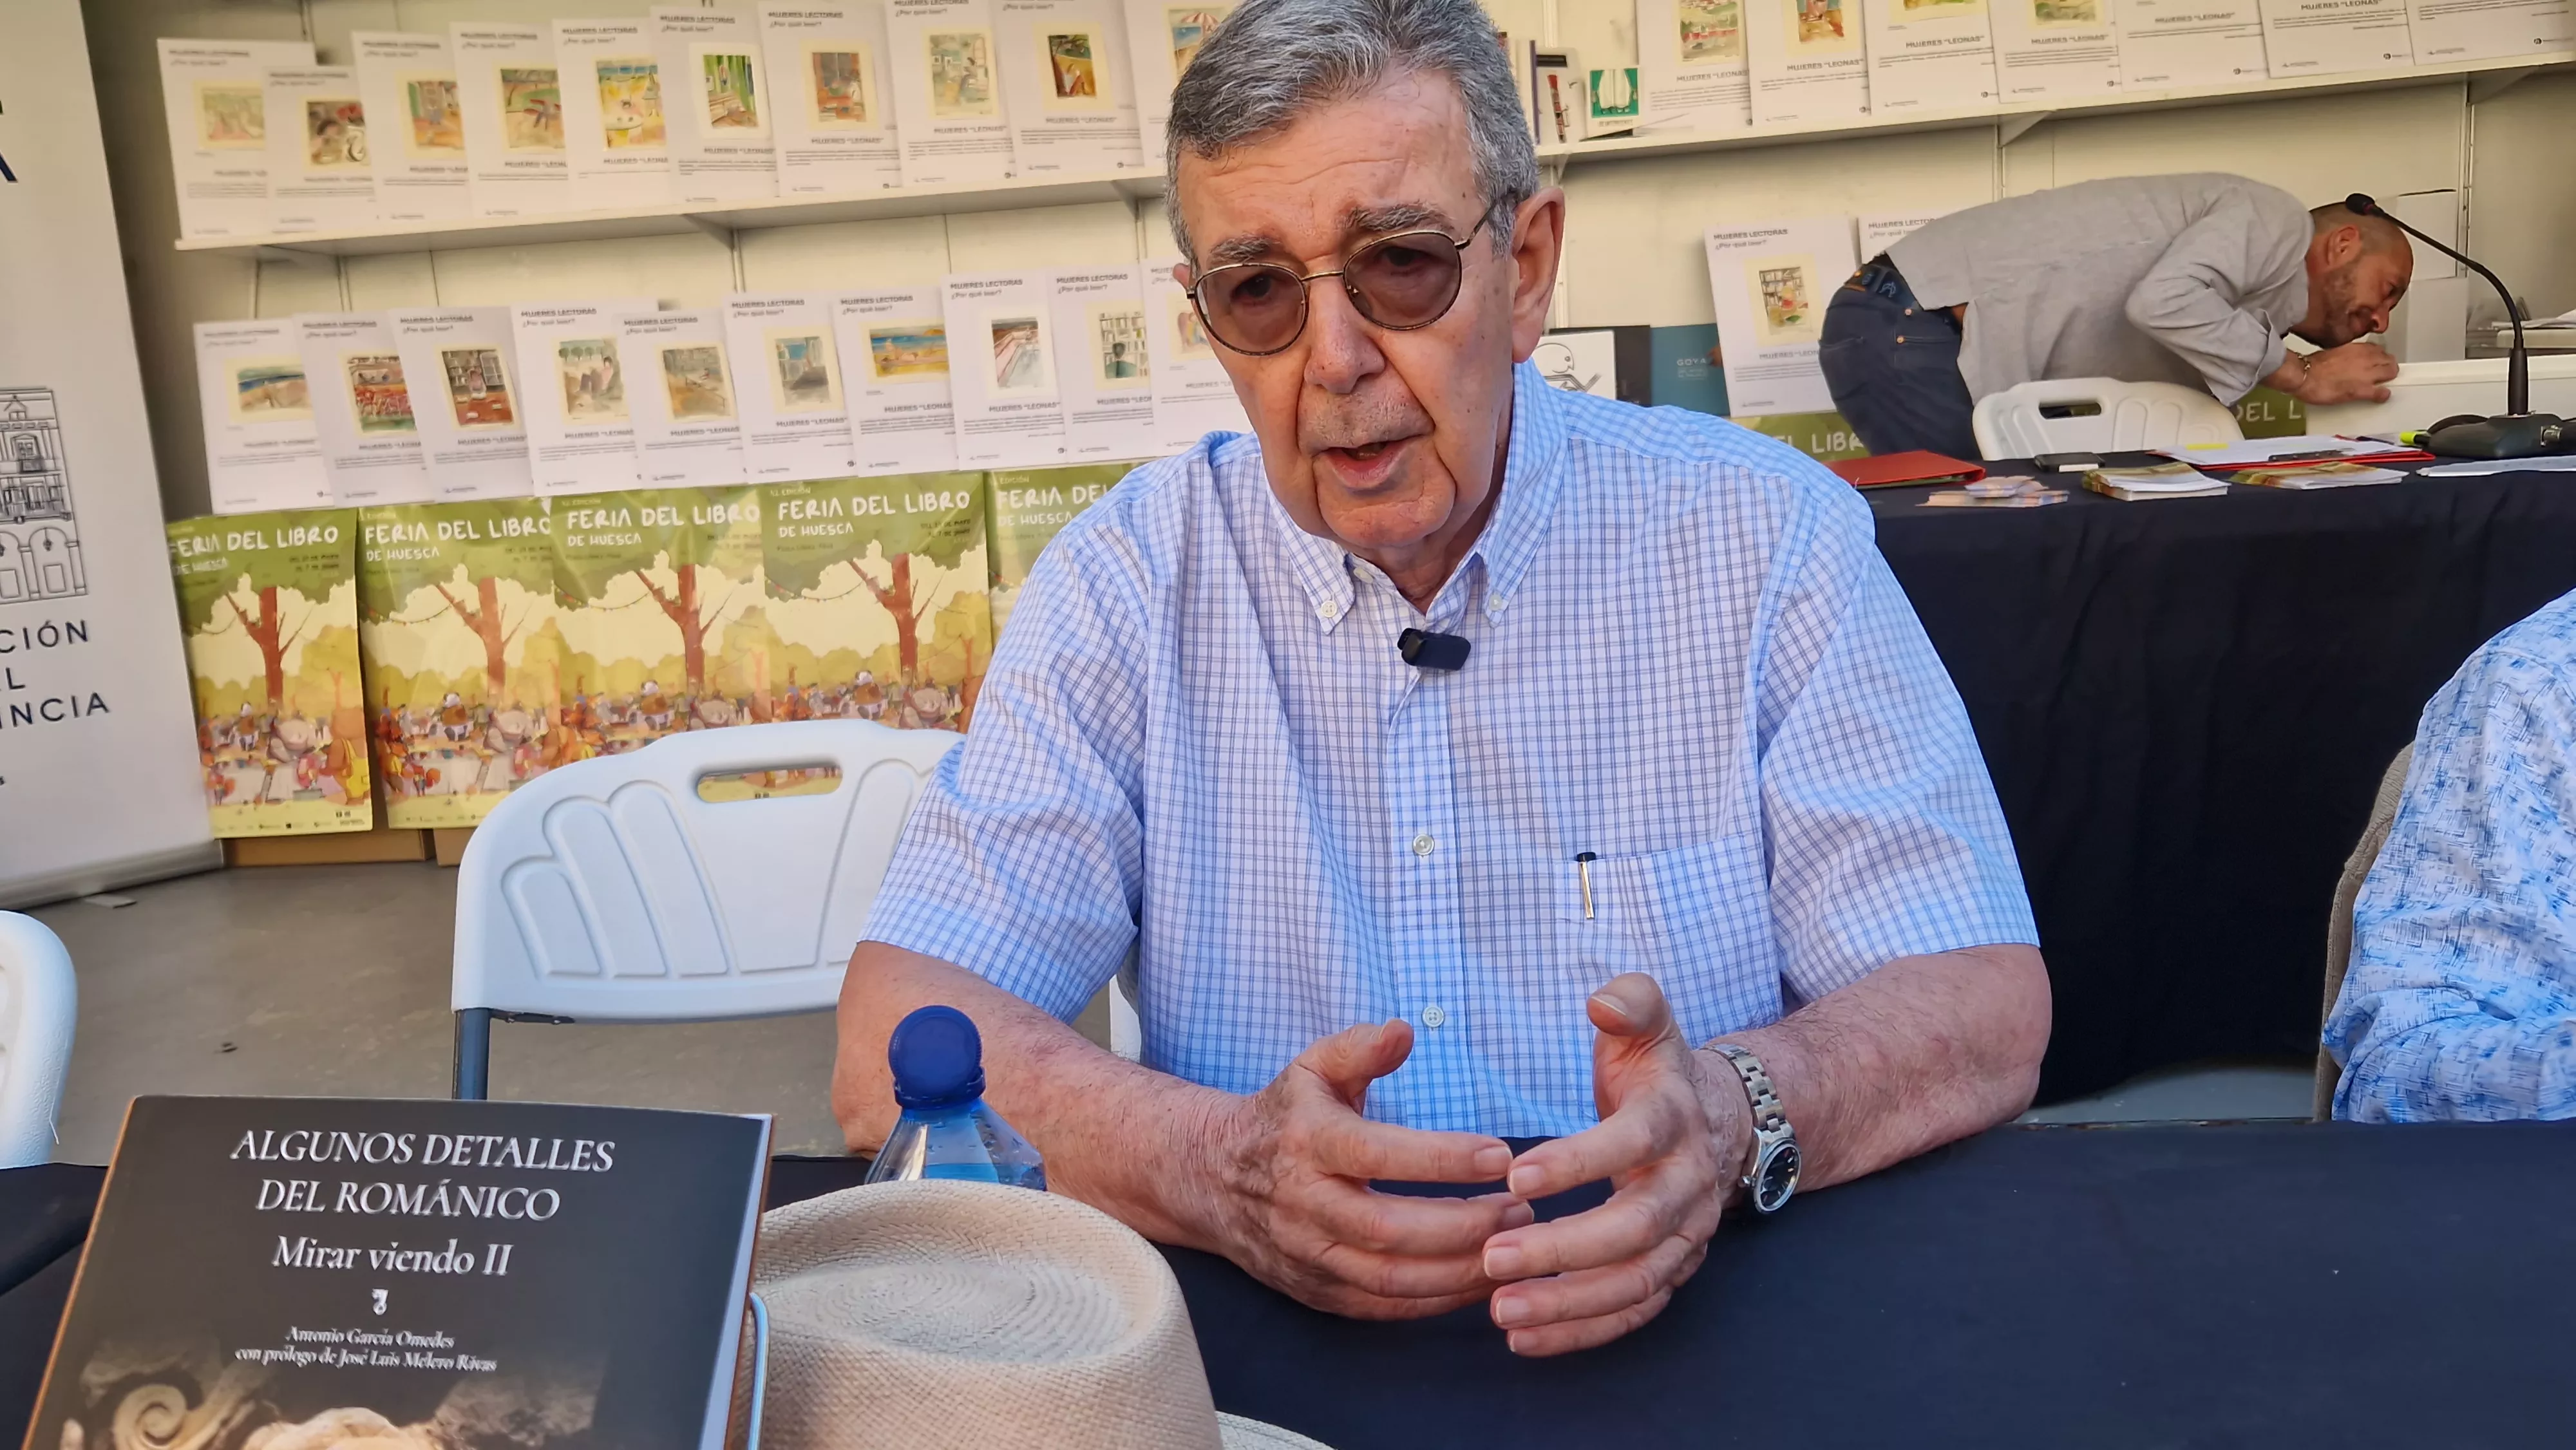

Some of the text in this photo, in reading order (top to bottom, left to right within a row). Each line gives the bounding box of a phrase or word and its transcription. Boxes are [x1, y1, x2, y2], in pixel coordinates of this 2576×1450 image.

[2301, 1, 2339, 10] MUJERES
[1906, 39, 1942, 49] MUJERES
[1787, 63, 1822, 71] MUJERES
[1677, 358, 1707, 366] GOYA
[778, 491, 971, 520] FERIA DEL LIBRO
[998, 487, 1063, 509] FERIA
[567, 504, 760, 529] FERIA DEL LIBRO
[999, 511, 1073, 527] DE HUESCA
[227, 530, 270, 551] DEL
[277, 525, 339, 548] LIBRO
[365, 516, 551, 545] FERIA DEL LIBRO
[568, 532, 641, 547] DE HUESCA
[779, 522, 854, 538] DE HUESCA
[366, 545, 439, 562] DE HUESCA
[0, 619, 88, 654] CIÓN
[230, 1130, 616, 1173] ALGUNOS DETALLES
[256, 1178, 561, 1221] DEL ROMÁNICO
[271, 1236, 514, 1276] Mirar viendo II
[285, 1326, 455, 1349] Antonio García Omedes
[234, 1344, 498, 1372] con prólogo de José Luis Melero Rivas
